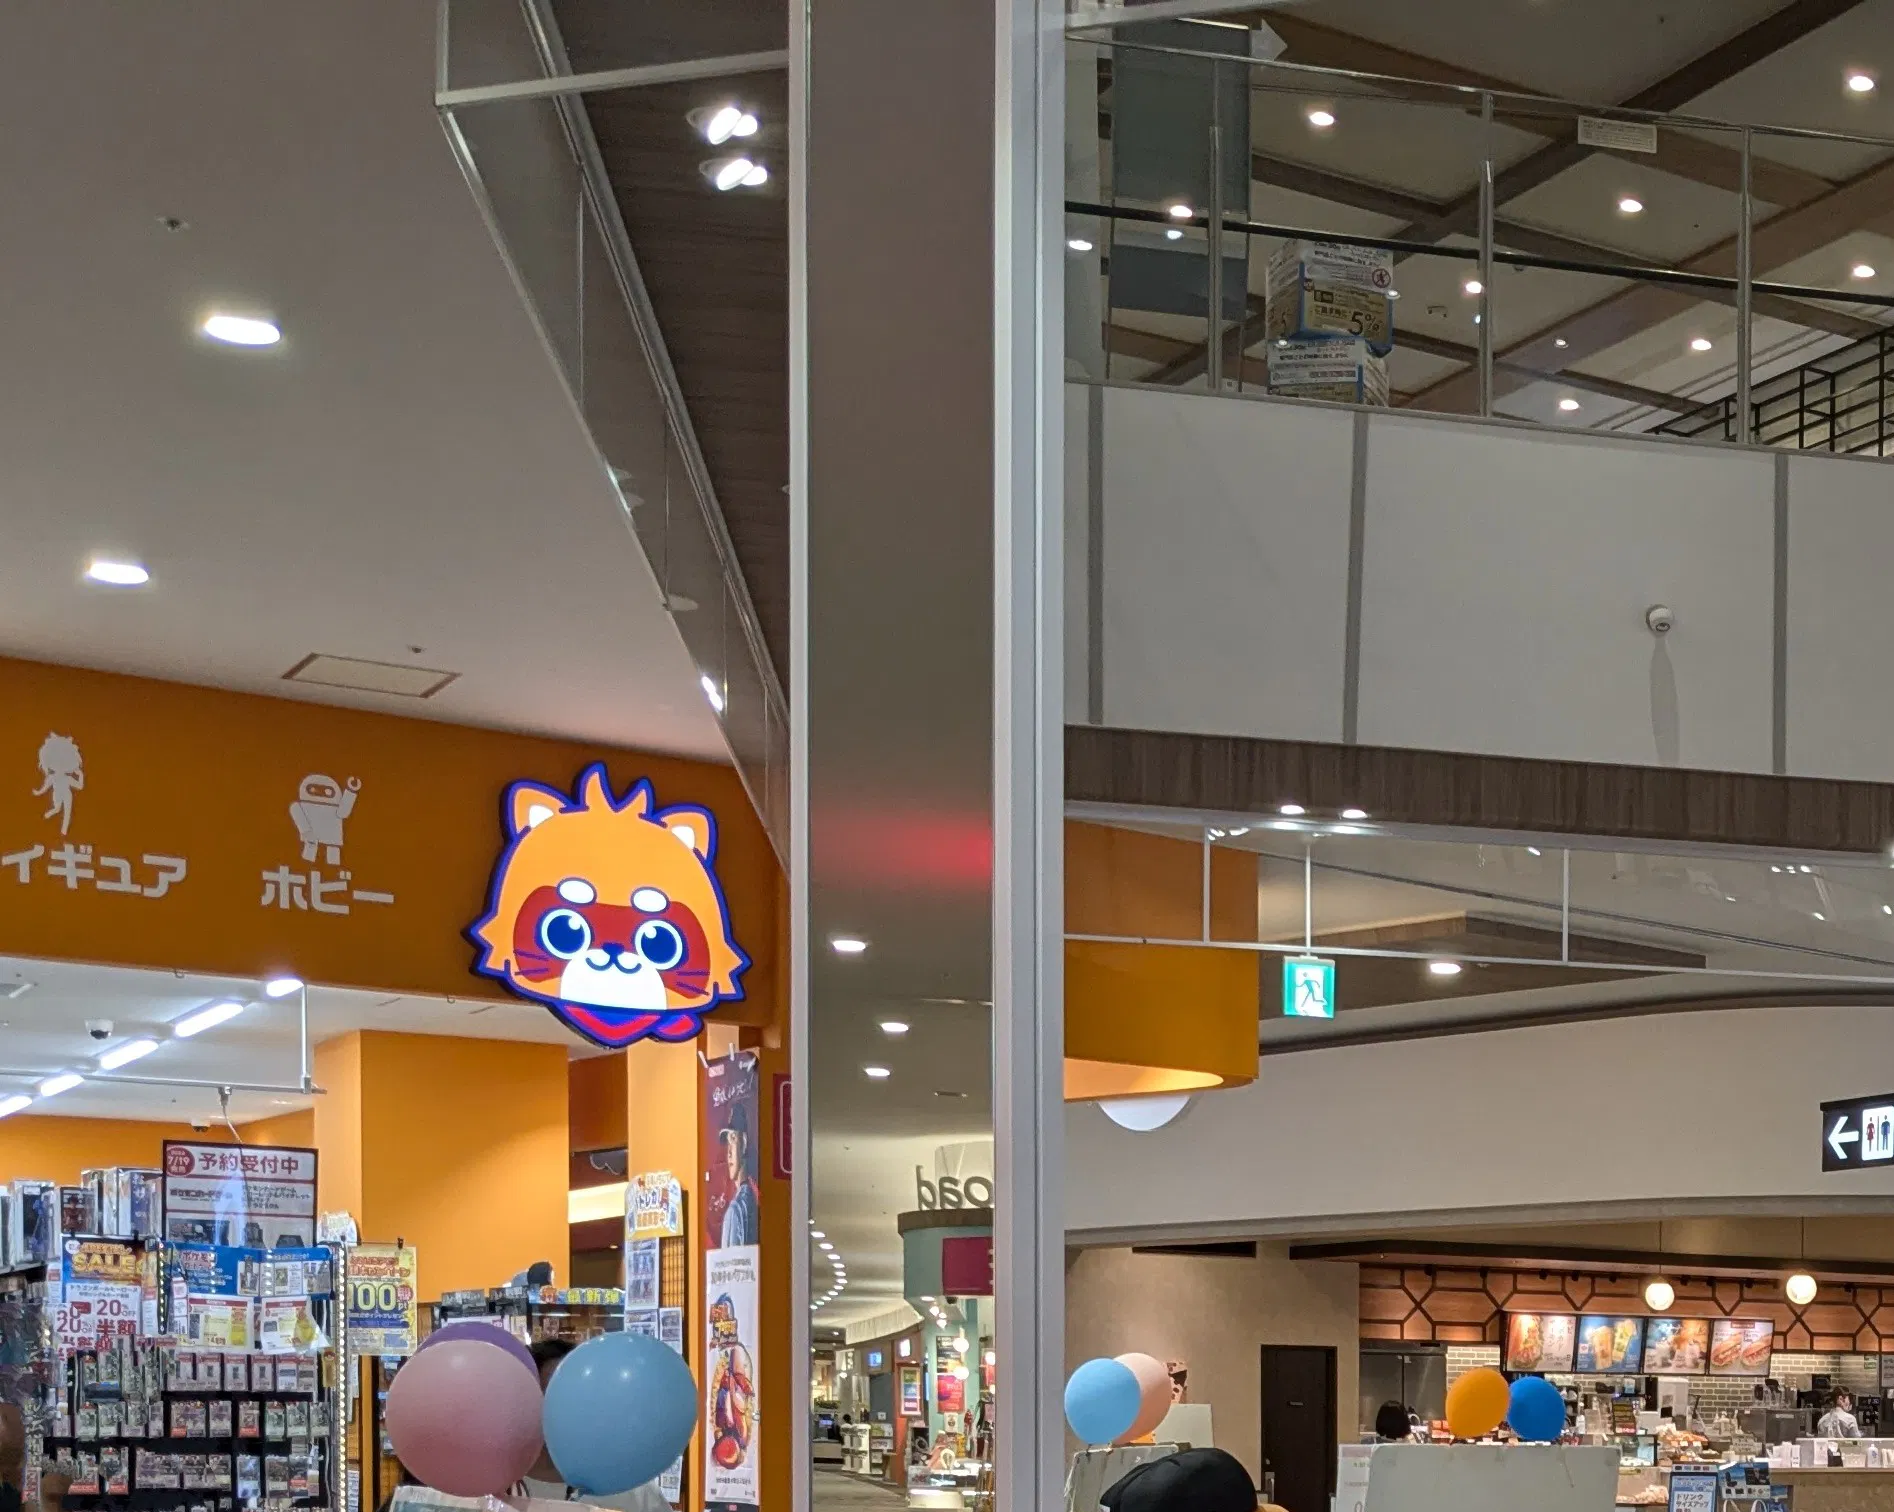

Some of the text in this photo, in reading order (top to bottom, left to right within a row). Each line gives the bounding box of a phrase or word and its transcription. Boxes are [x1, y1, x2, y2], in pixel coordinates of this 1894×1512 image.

[1350, 311, 1381, 336] 5%
[261, 865, 395, 914] ホビー
[198, 1151, 299, 1174] 予約受付中
[72, 1252, 137, 1273] SALE
[97, 1299, 122, 1317] 20
